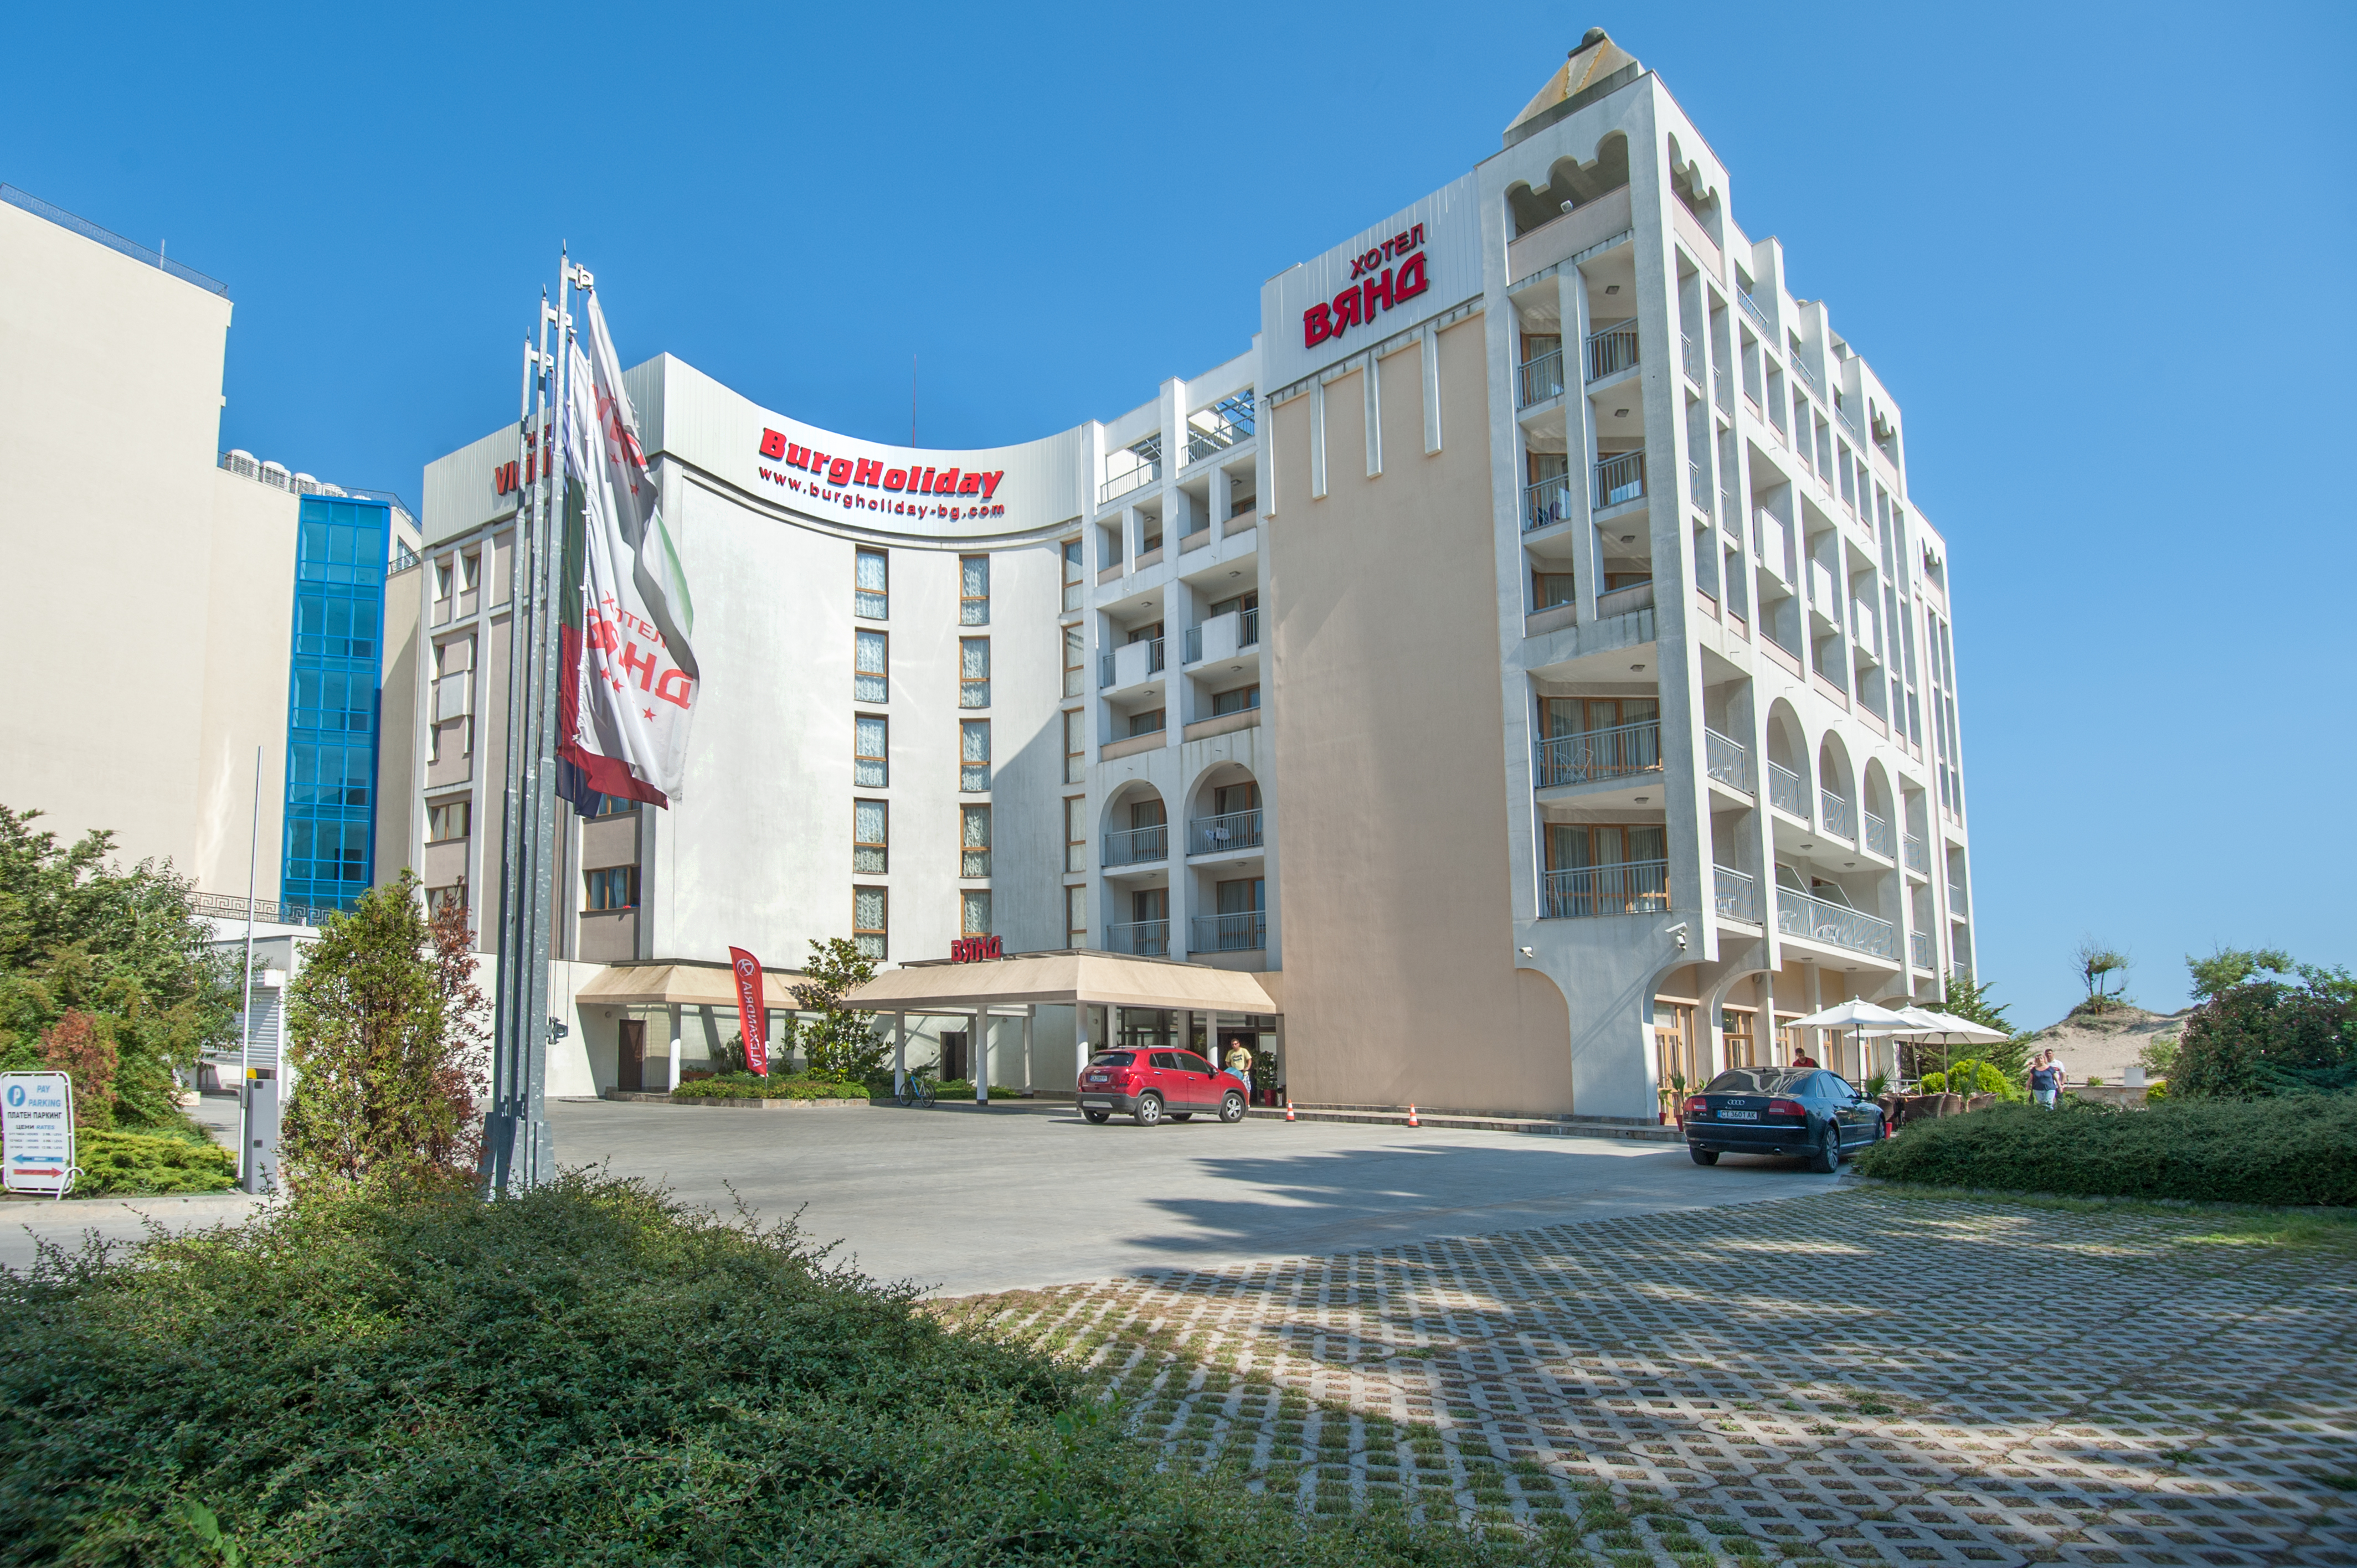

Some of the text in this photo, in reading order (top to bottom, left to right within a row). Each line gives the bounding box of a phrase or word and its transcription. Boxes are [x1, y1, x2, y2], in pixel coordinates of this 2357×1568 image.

[1350, 223, 1425, 280] ХОТЕЛ
[1303, 251, 1430, 349] ВЯНД
[759, 427, 1004, 498] BurgHoliday
[759, 467, 1005, 520] www.burgholiday-bg.com
[951, 935, 1001, 963] ВЯНД
